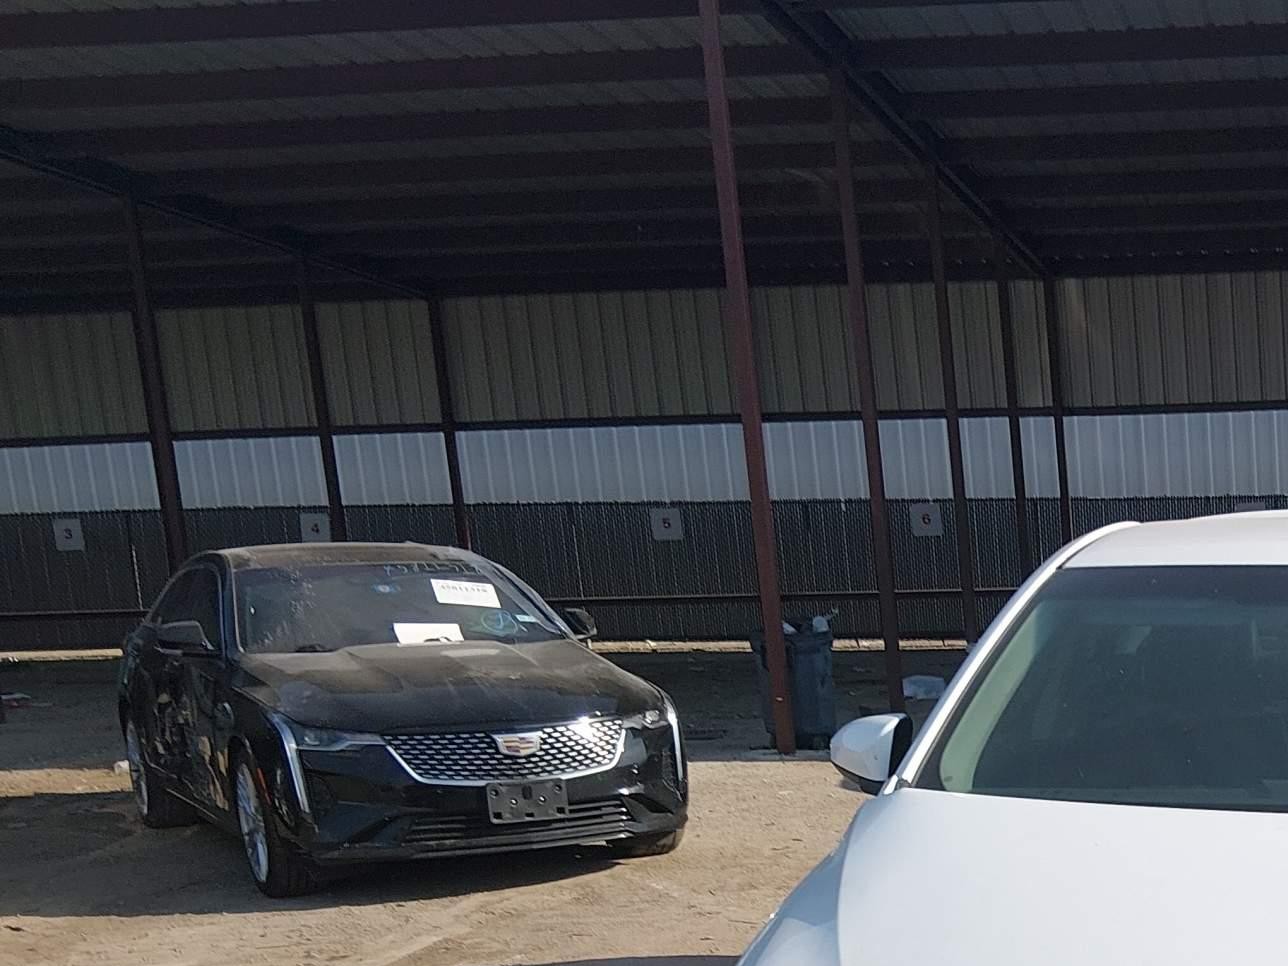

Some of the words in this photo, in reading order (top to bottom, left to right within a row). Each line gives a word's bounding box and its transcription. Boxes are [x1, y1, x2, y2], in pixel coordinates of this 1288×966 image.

[661, 517, 671, 528] 5
[922, 514, 932, 525] 6
[63, 528, 73, 540] 3
[311, 523, 320, 534] 4
